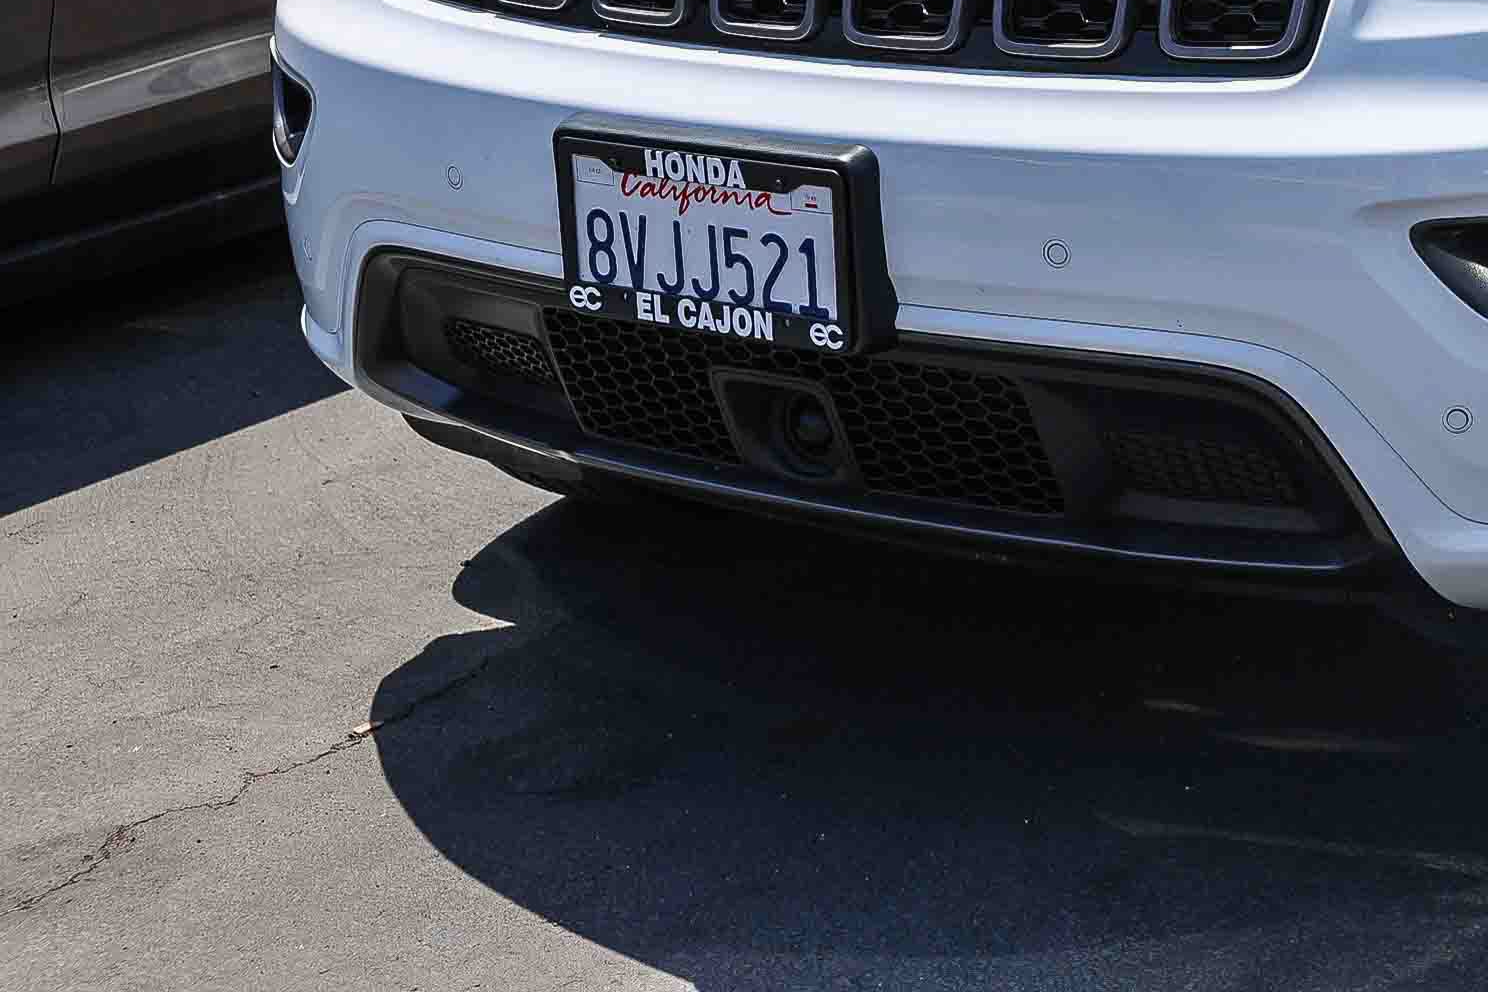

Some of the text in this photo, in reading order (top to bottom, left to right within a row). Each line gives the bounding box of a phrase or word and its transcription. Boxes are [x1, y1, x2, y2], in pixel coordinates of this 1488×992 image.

[620, 170, 792, 216] California
[644, 149, 746, 189] HONDA
[586, 207, 830, 319] 8VJJ521
[636, 291, 774, 341] EL CAJON
